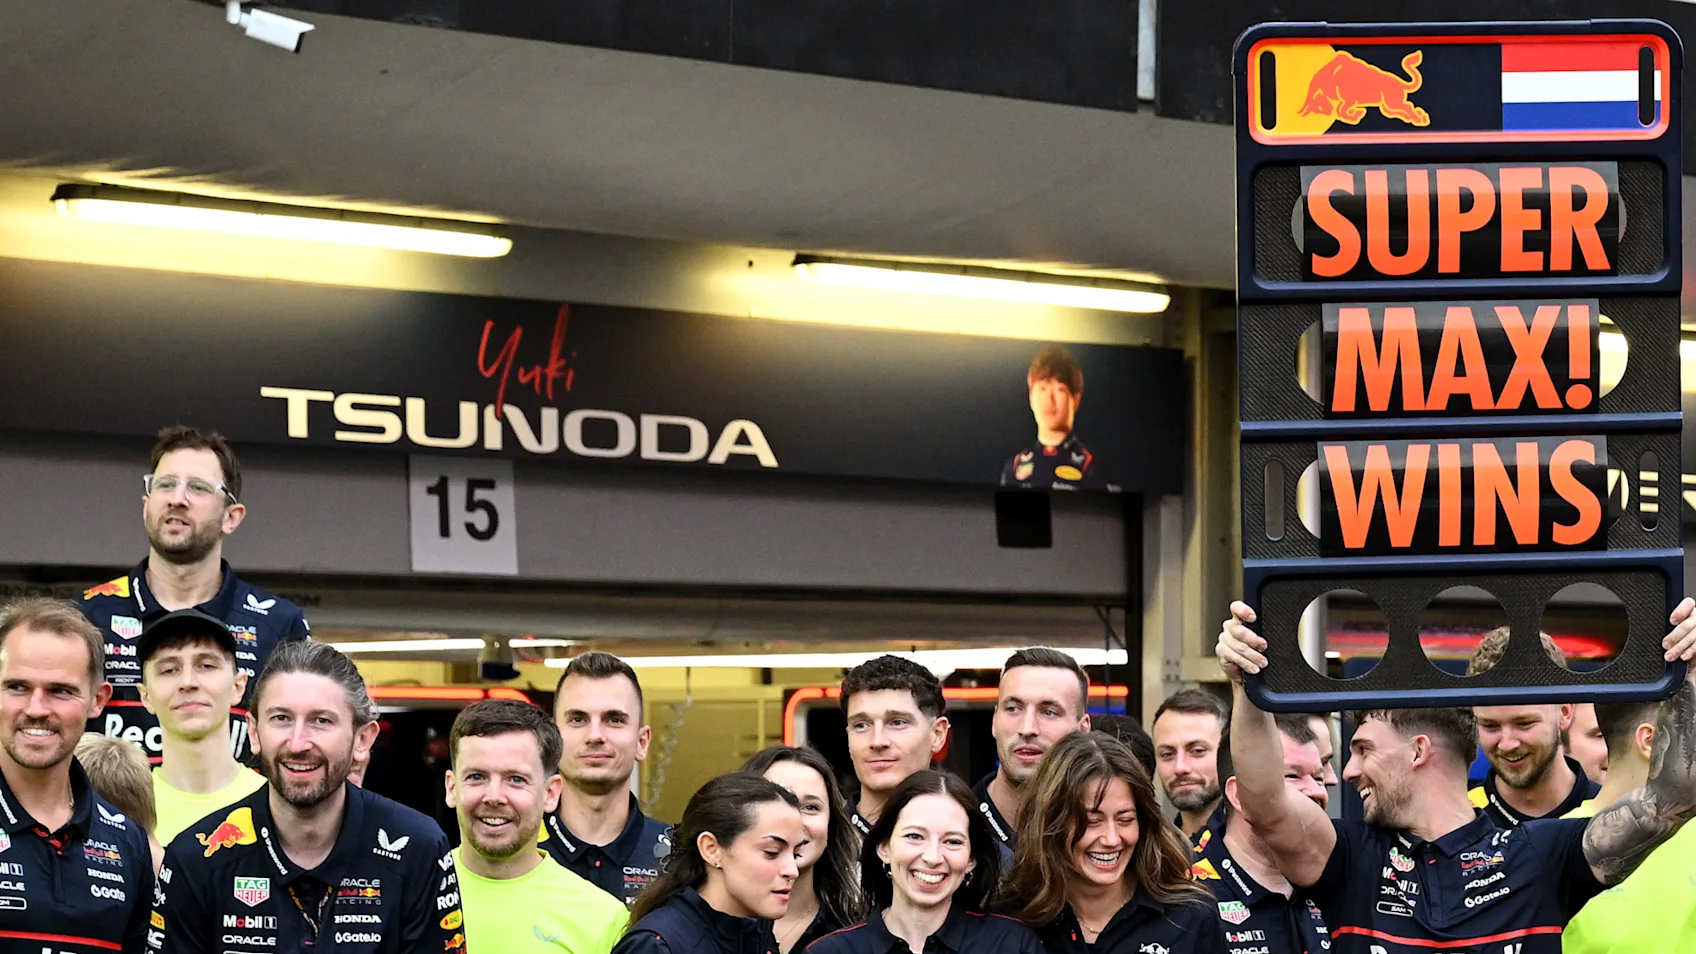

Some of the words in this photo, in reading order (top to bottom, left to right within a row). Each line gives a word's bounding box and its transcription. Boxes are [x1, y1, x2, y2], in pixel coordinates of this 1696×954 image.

[1308, 166, 1610, 276] SUPER
[478, 305, 576, 417] Yuki
[1331, 305, 1591, 412] MAX!
[261, 387, 778, 467] TSUNODA
[1324, 440, 1602, 548] WINS
[426, 475, 498, 541] 15
[87, 868, 124, 883] HONDA
[240, 878, 267, 891] TAG
[1228, 867, 1252, 897] 1Password
[235, 890, 269, 903] HEUER
[223, 914, 263, 930] Mobil
[334, 914, 382, 924] HONDA
[222, 935, 276, 946] ORACLE
[346, 932, 381, 943] Gate.io
